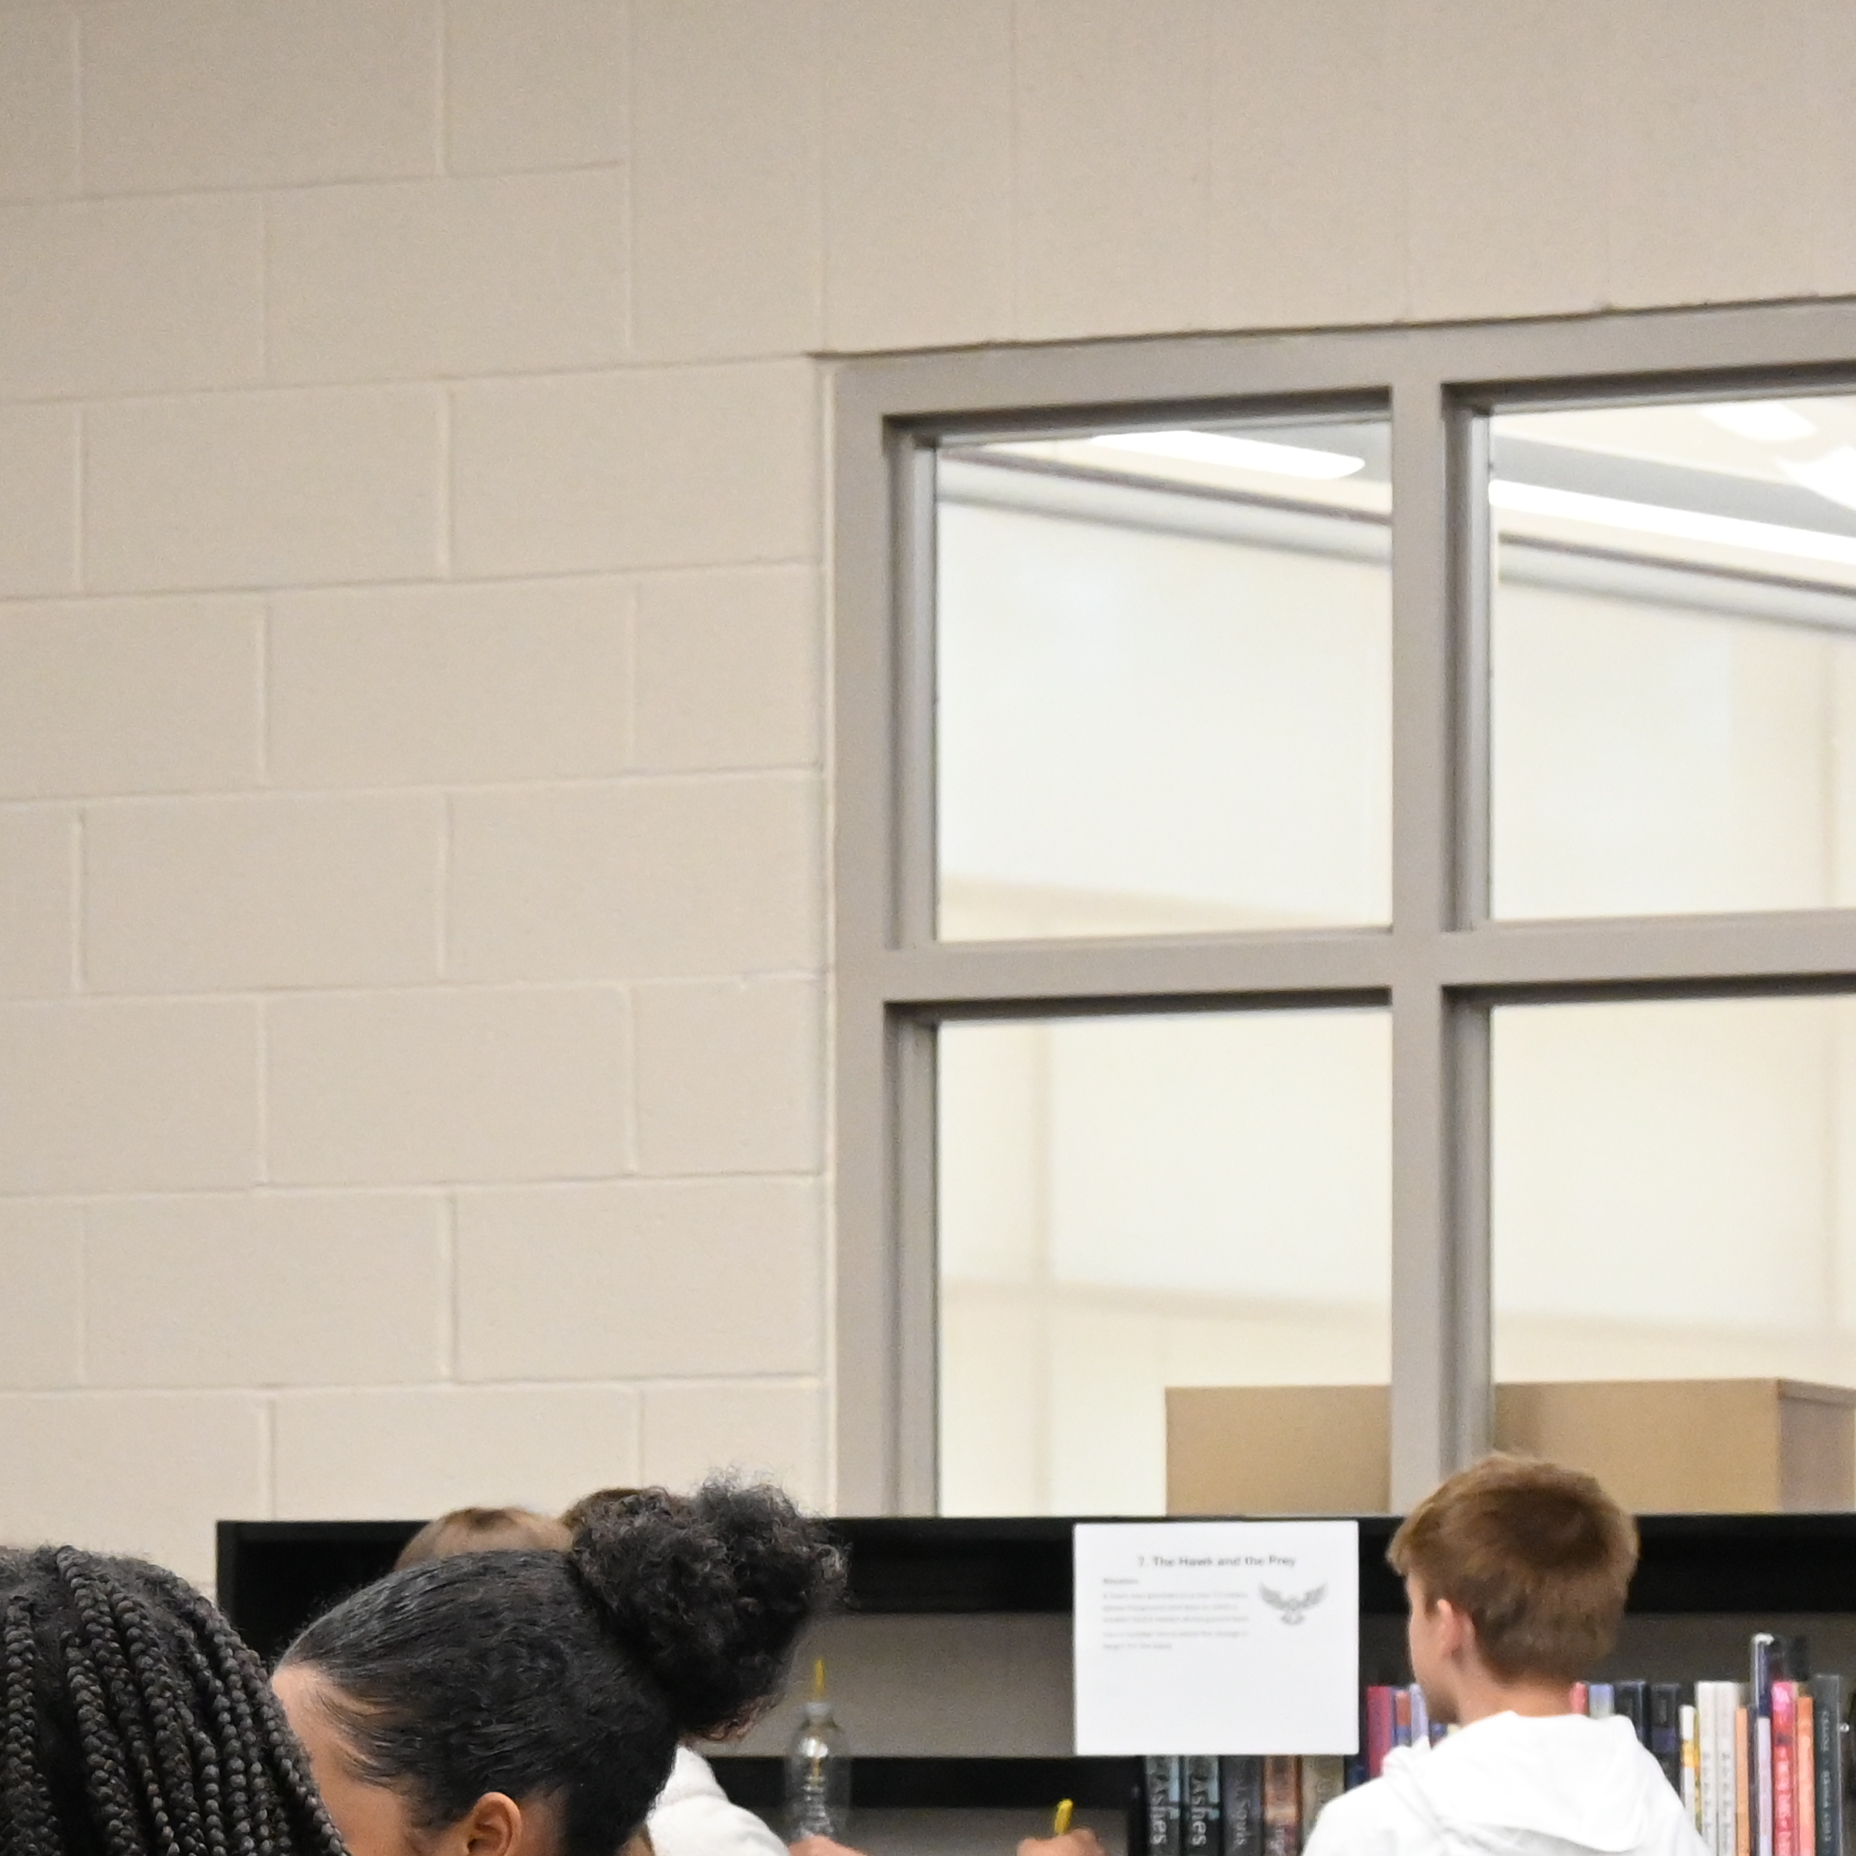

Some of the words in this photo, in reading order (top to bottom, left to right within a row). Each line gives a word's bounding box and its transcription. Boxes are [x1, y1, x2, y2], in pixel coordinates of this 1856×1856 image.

[1153, 1557, 1175, 1567] The
[1179, 1557, 1213, 1566] Hawk
[1217, 1557, 1241, 1566] and
[1245, 1556, 1265, 1566] the
[1268, 1556, 1295, 1567] Prey
